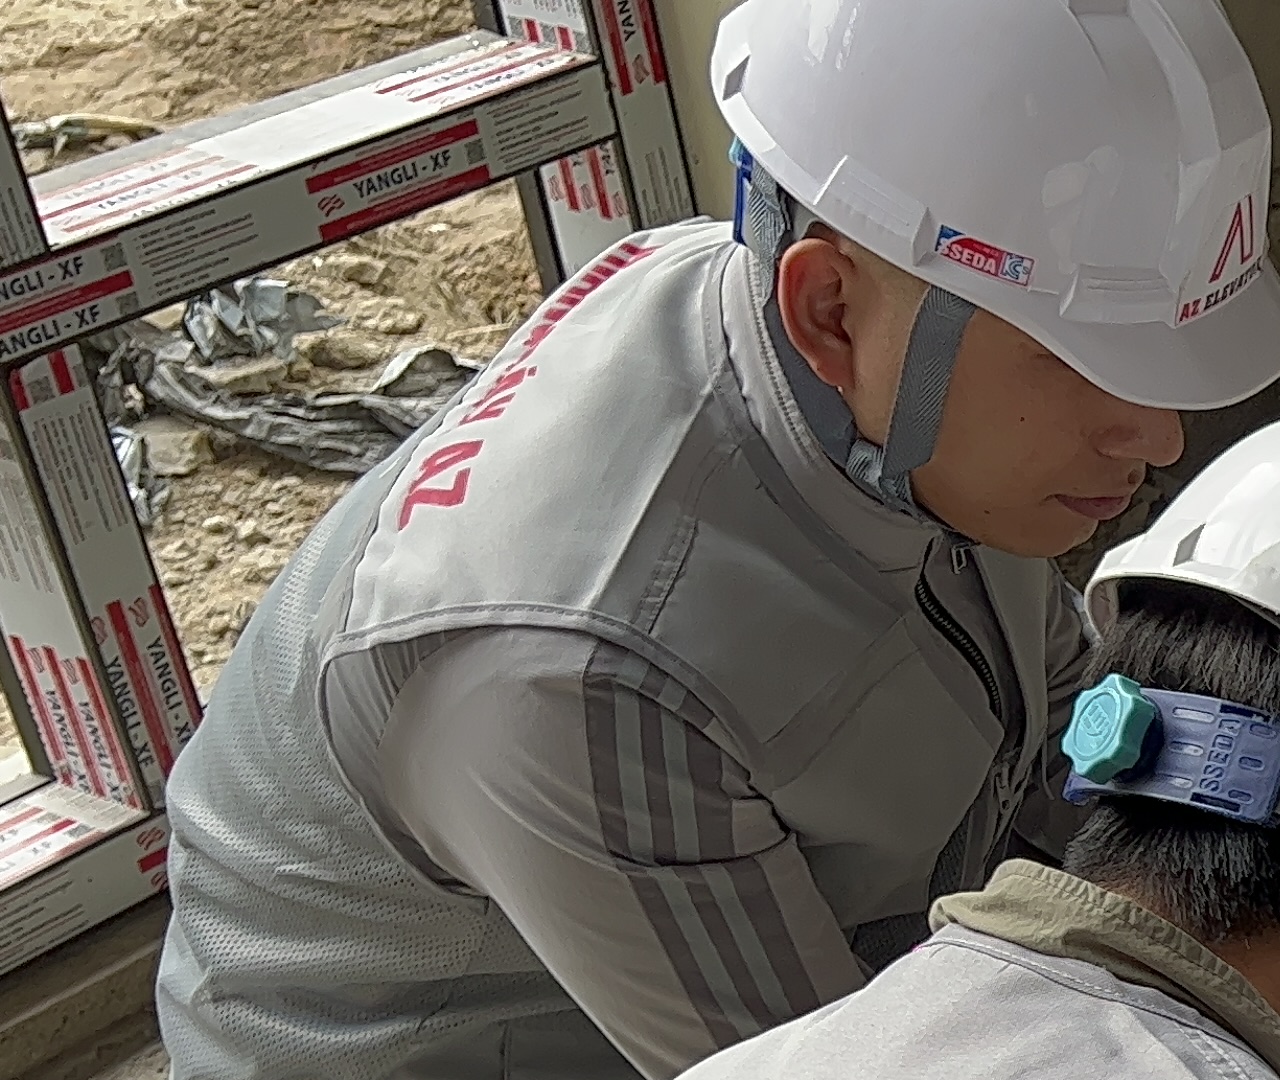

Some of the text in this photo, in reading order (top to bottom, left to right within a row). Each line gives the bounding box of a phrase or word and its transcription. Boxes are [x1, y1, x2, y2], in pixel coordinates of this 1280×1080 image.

[353, 162, 418, 199] YANGLI
[430, 150, 452, 172] XF
[0, 270, 45, 300] NGLI
[58, 256, 84, 281] XF
[0, 319, 60, 358] ANGLI
[74, 304, 100, 329] XF
[1179, 298, 1202, 322] AZ
[397, 438, 486, 533] AZ
[147, 635, 182, 711] YANGLI
[104, 655, 142, 731] YANGLI
[136, 742, 157, 769] XF
